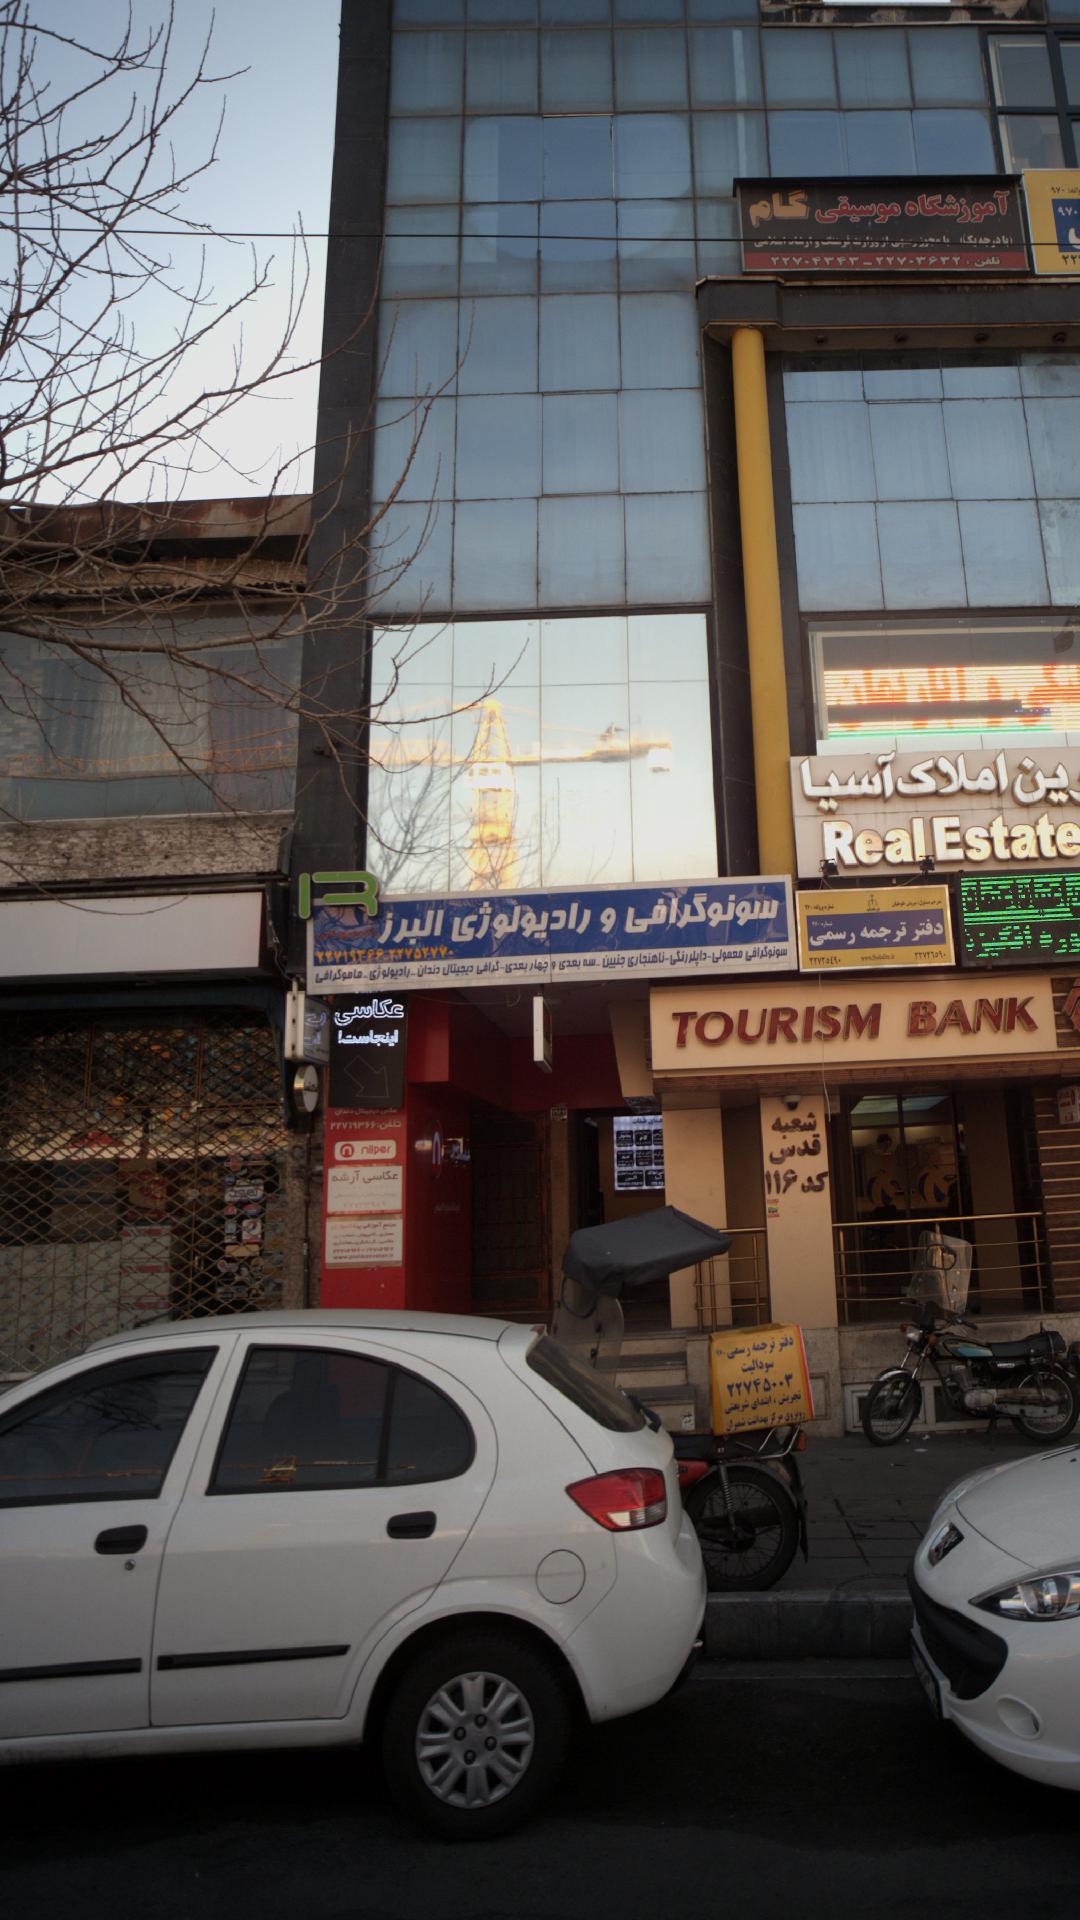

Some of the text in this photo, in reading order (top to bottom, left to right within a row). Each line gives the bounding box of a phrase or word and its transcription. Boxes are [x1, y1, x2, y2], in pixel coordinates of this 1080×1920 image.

[815, 196, 902, 224] موسیقی
[905, 190, 1010, 224] آموزشگاه
[800, 749, 897, 815] آسیا
[896, 750, 1009, 798] املاک
[821, 813, 1080, 868] Real Estate
[377, 908, 446, 945] البرز
[450, 900, 592, 944] رادیولوژی
[600, 906, 618, 935] و
[624, 892, 780, 935] سونوگرافی
[809, 919, 944, 947] دفتر ترجمه رسمی
[530, 959, 549, 974] چهار
[745, 946, 788, 962] سونوگرافی
[442, 963, 474, 977] دیجیتال
[334, 999, 405, 1027] عکاسی
[671, 996, 1039, 1049] TOURISM BANK
[771, 1112, 818, 1140] شعبه
[769, 1133, 822, 1165] قدس
[362, 1170, 400, 1184] عکاسی
[765, 1169, 829, 1195] کد ۱۱۶
[727, 1347, 750, 1360] رسمی
[752, 1336, 776, 1355] ترجمه
[779, 1336, 794, 1353] دفتر
[727, 1373, 793, 1398] ۲۲۷۴۵۰۰۳
